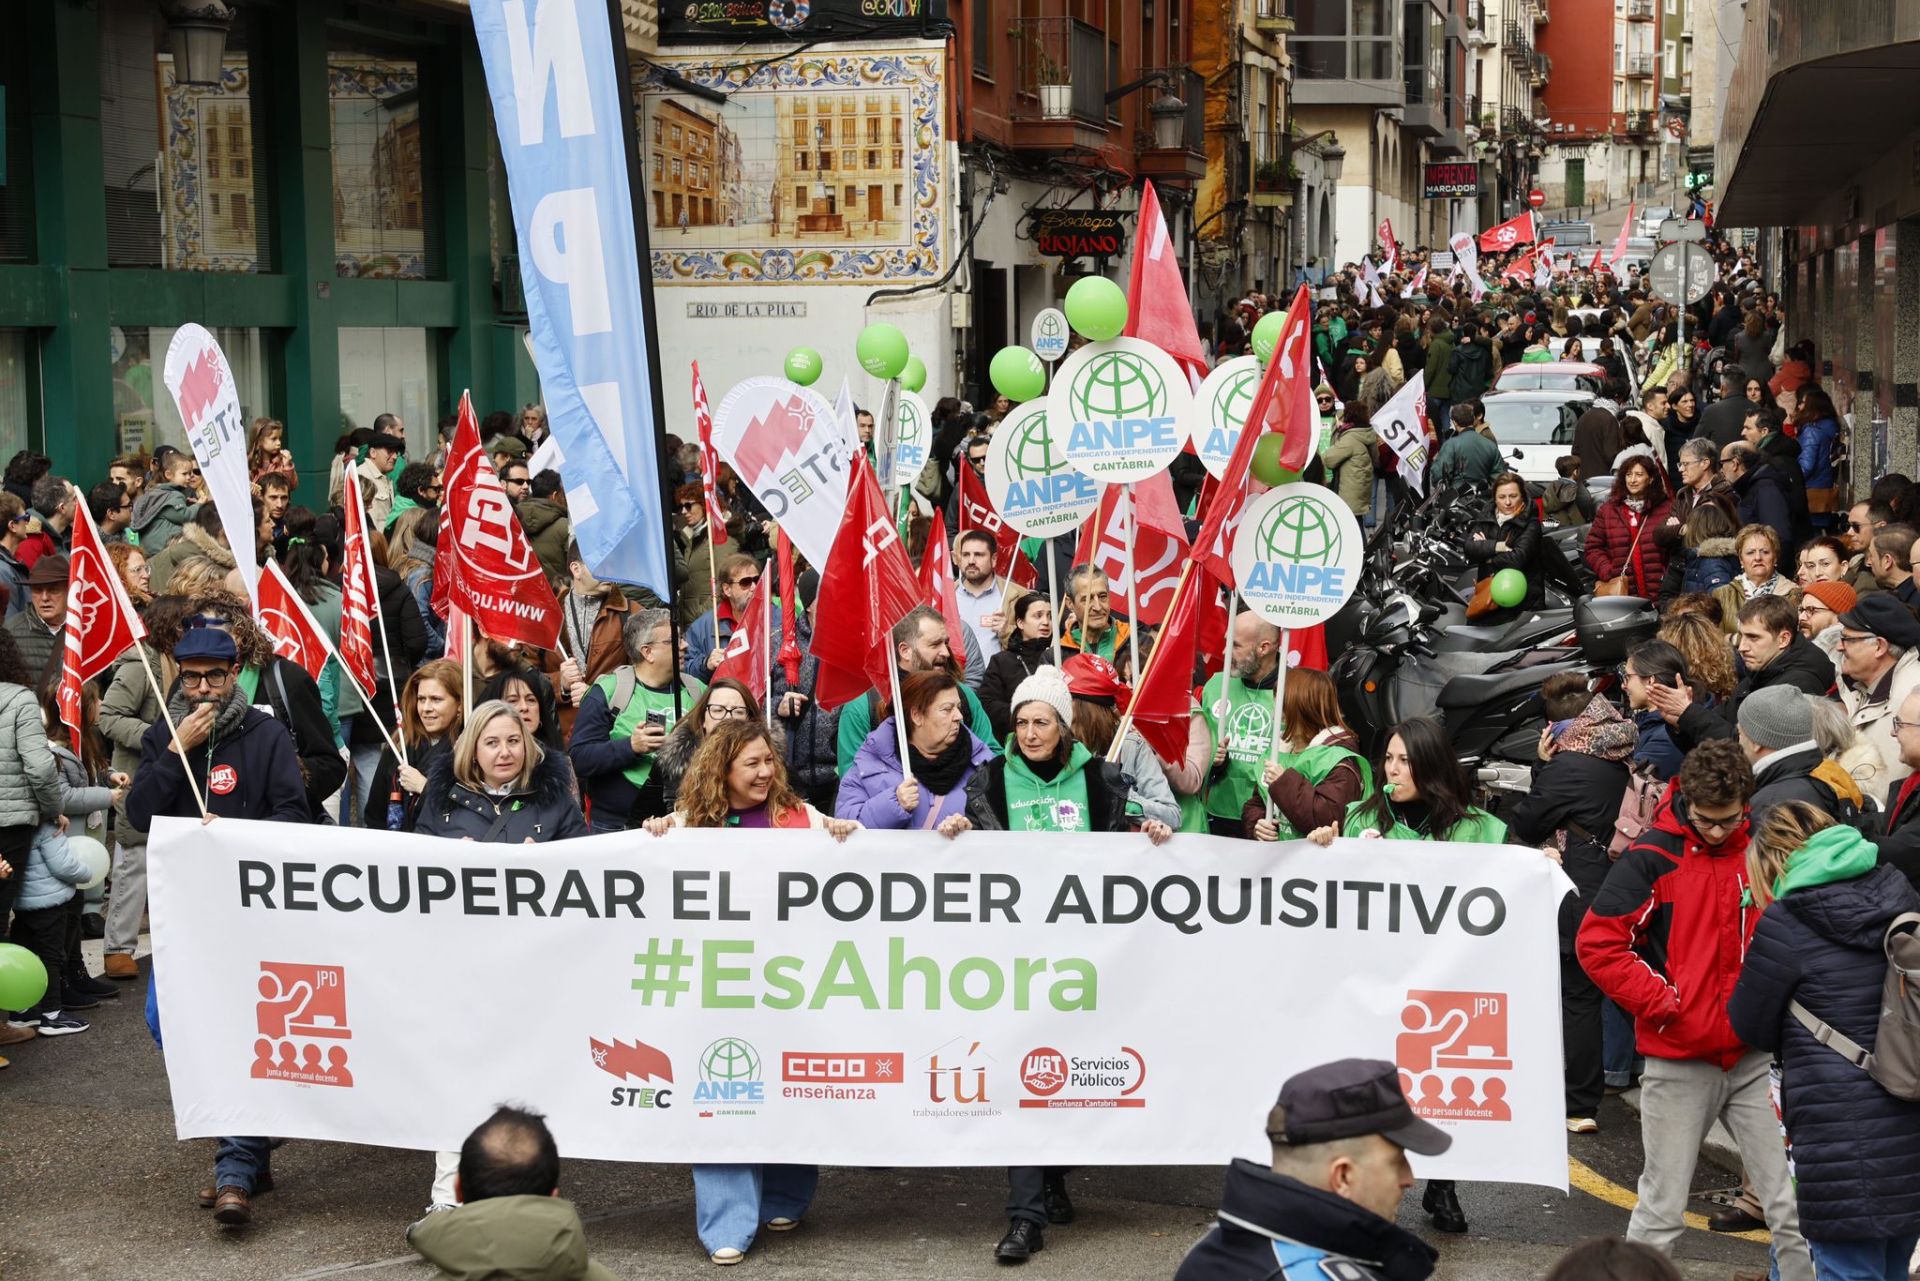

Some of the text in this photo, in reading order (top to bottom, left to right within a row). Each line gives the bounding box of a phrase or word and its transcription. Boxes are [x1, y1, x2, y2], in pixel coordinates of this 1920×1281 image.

[1426, 164, 1477, 185] IMPRENTA
[1426, 184, 1476, 192] MARCADOR
[1042, 210, 1116, 231] Bodega
[1039, 234, 1118, 256] RIOJANO
[724, 303, 739, 317] DE
[746, 303, 760, 317] LA
[767, 303, 797, 317] PILA
[1036, 337, 1064, 350] ANPE
[1066, 416, 1178, 453] ANPE
[1066, 447, 1178, 460] SINDICATO INDEPENDIENTE
[1093, 459, 1155, 472] CANTABRIA
[1003, 470, 1098, 512] ANPE
[1003, 497, 1098, 519] SINDICATO INDEPENDIENTE
[1026, 511, 1079, 528] CANTABRIA
[1244, 561, 1346, 597] ANPE
[1243, 590, 1342, 604] SINDICATO INDEPENDIENTE
[1265, 604, 1320, 617] CANTABRIA
[1226, 732, 1272, 754] ANPE
[210, 768, 232, 783] UGT
[238, 859, 1507, 937] RECUPERAR EL PODER ADQUISITIVO
[316, 970, 338, 990] JPD
[631, 936, 1098, 1012] #EsAhora
[1473, 998, 1498, 1018] JPD
[788, 1058, 866, 1078] CCOO
[924, 1041, 991, 1104] tú
[1025, 1055, 1062, 1075] UGT
[1070, 1057, 1130, 1071] Servicios
[1070, 1073, 1126, 1087] Públicos
[610, 1086, 673, 1109] STEC
[693, 1081, 765, 1100] ANPE
[782, 1084, 876, 1100] enseñanza
[1084, 1099, 1118, 1108] Cantabria
[1421, 1106, 1431, 1115] de
[1432, 1107, 1464, 1117] personal
[1464, 1108, 1494, 1118] docente
[912, 1108, 1002, 1119] trabajadores unidos
